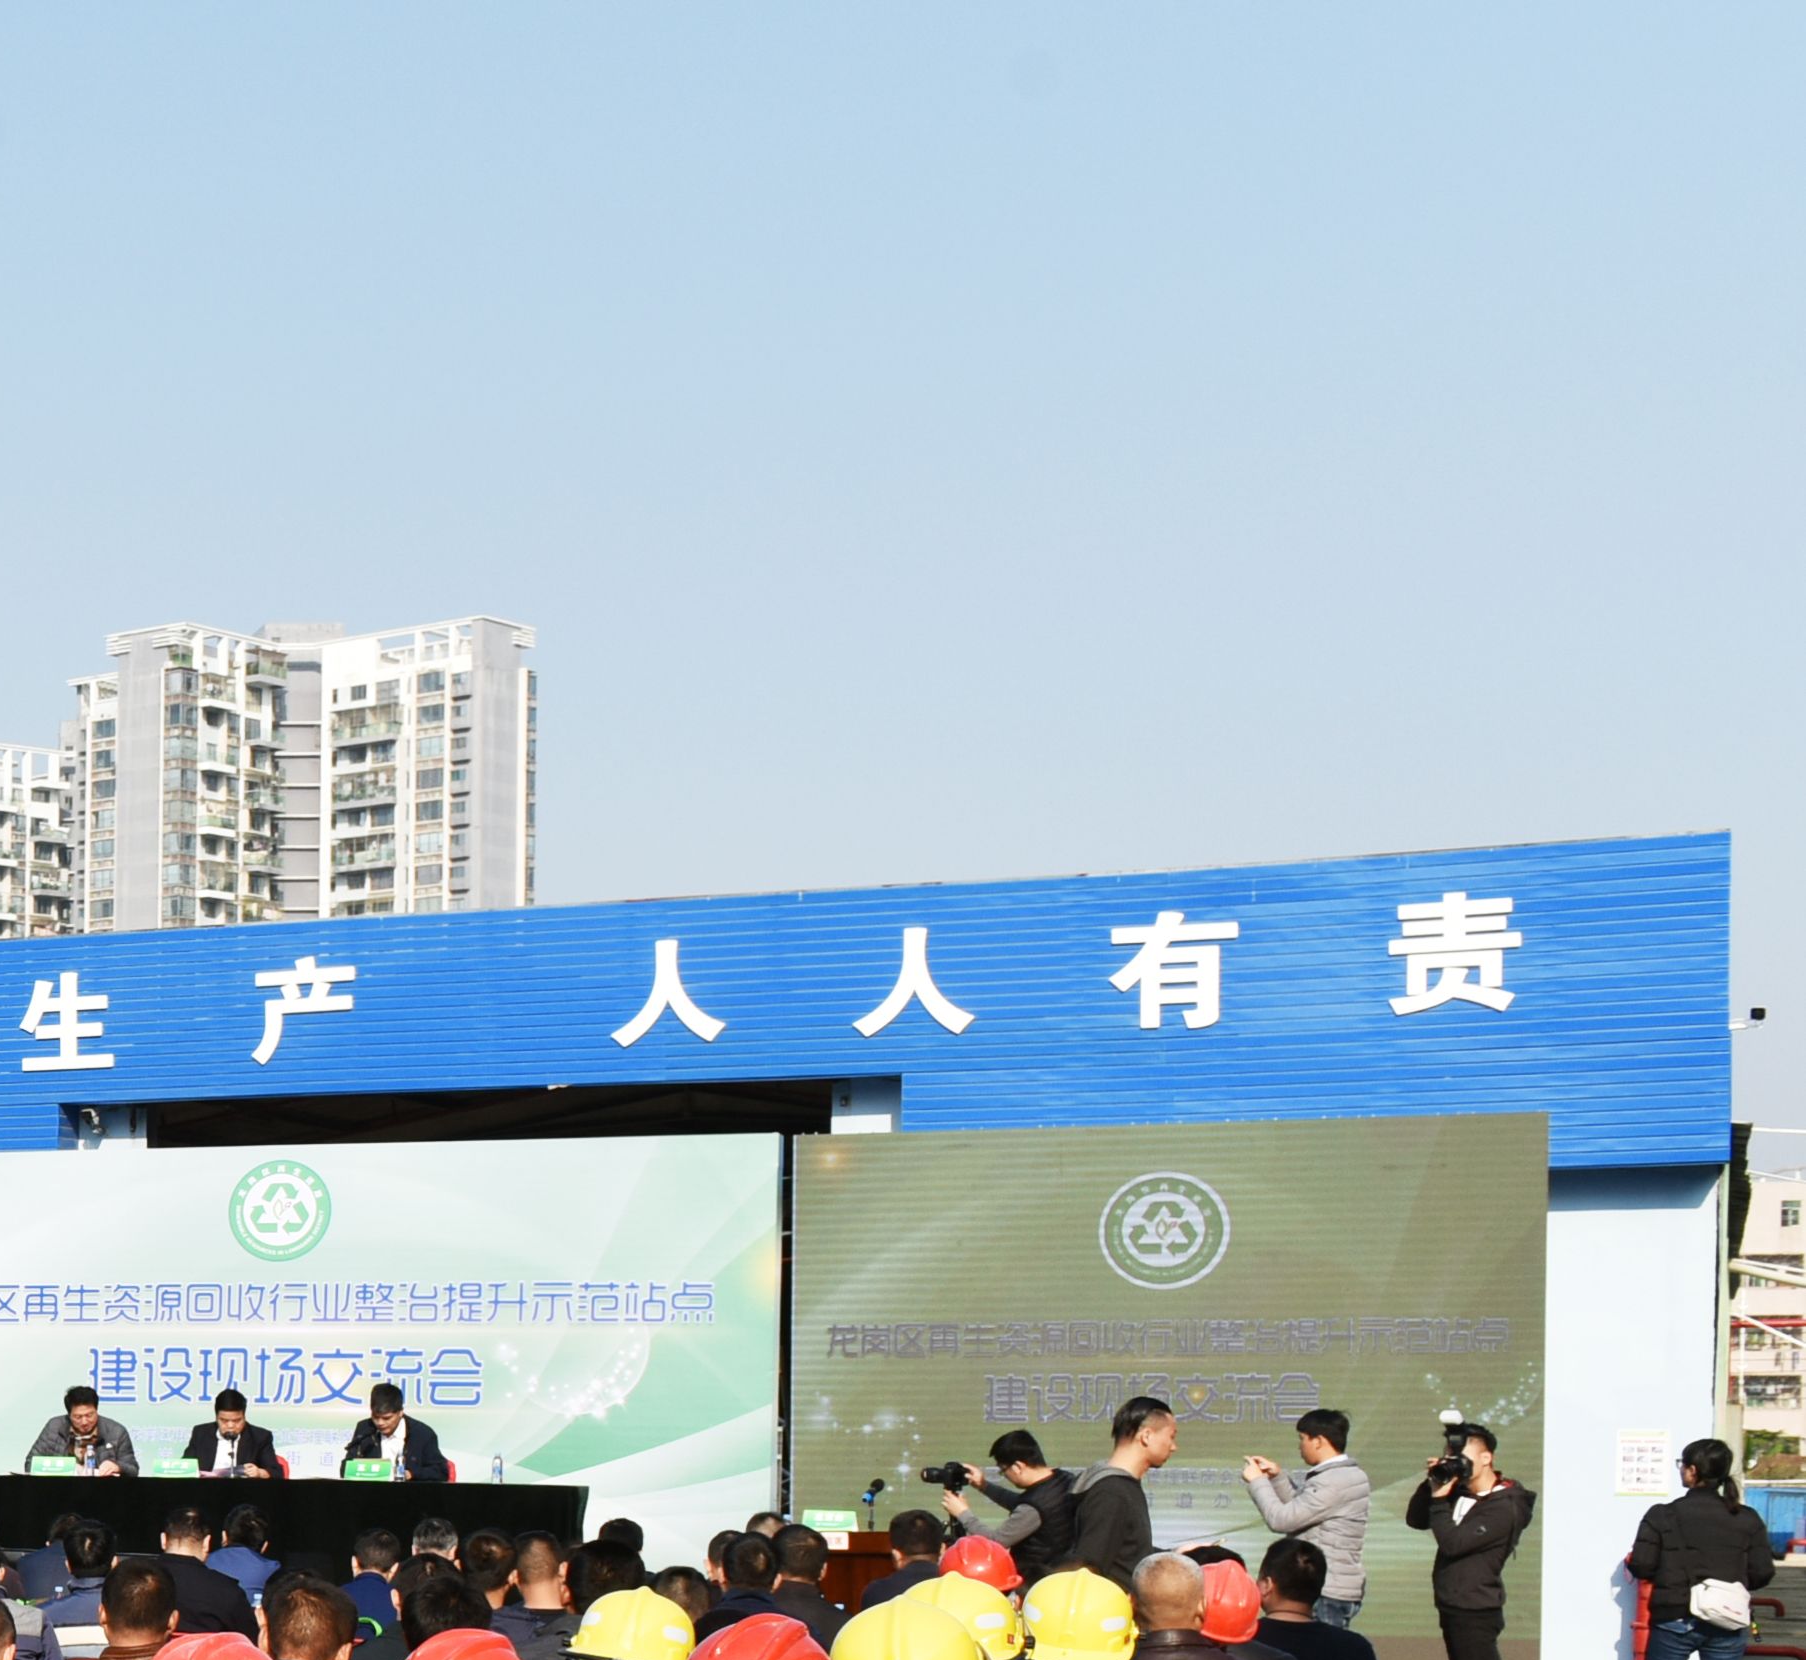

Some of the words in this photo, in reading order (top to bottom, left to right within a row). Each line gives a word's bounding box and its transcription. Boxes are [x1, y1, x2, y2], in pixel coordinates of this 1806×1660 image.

[611, 895, 1525, 1048] 人人有责
[88, 1346, 484, 1407] 建设现场交流会
